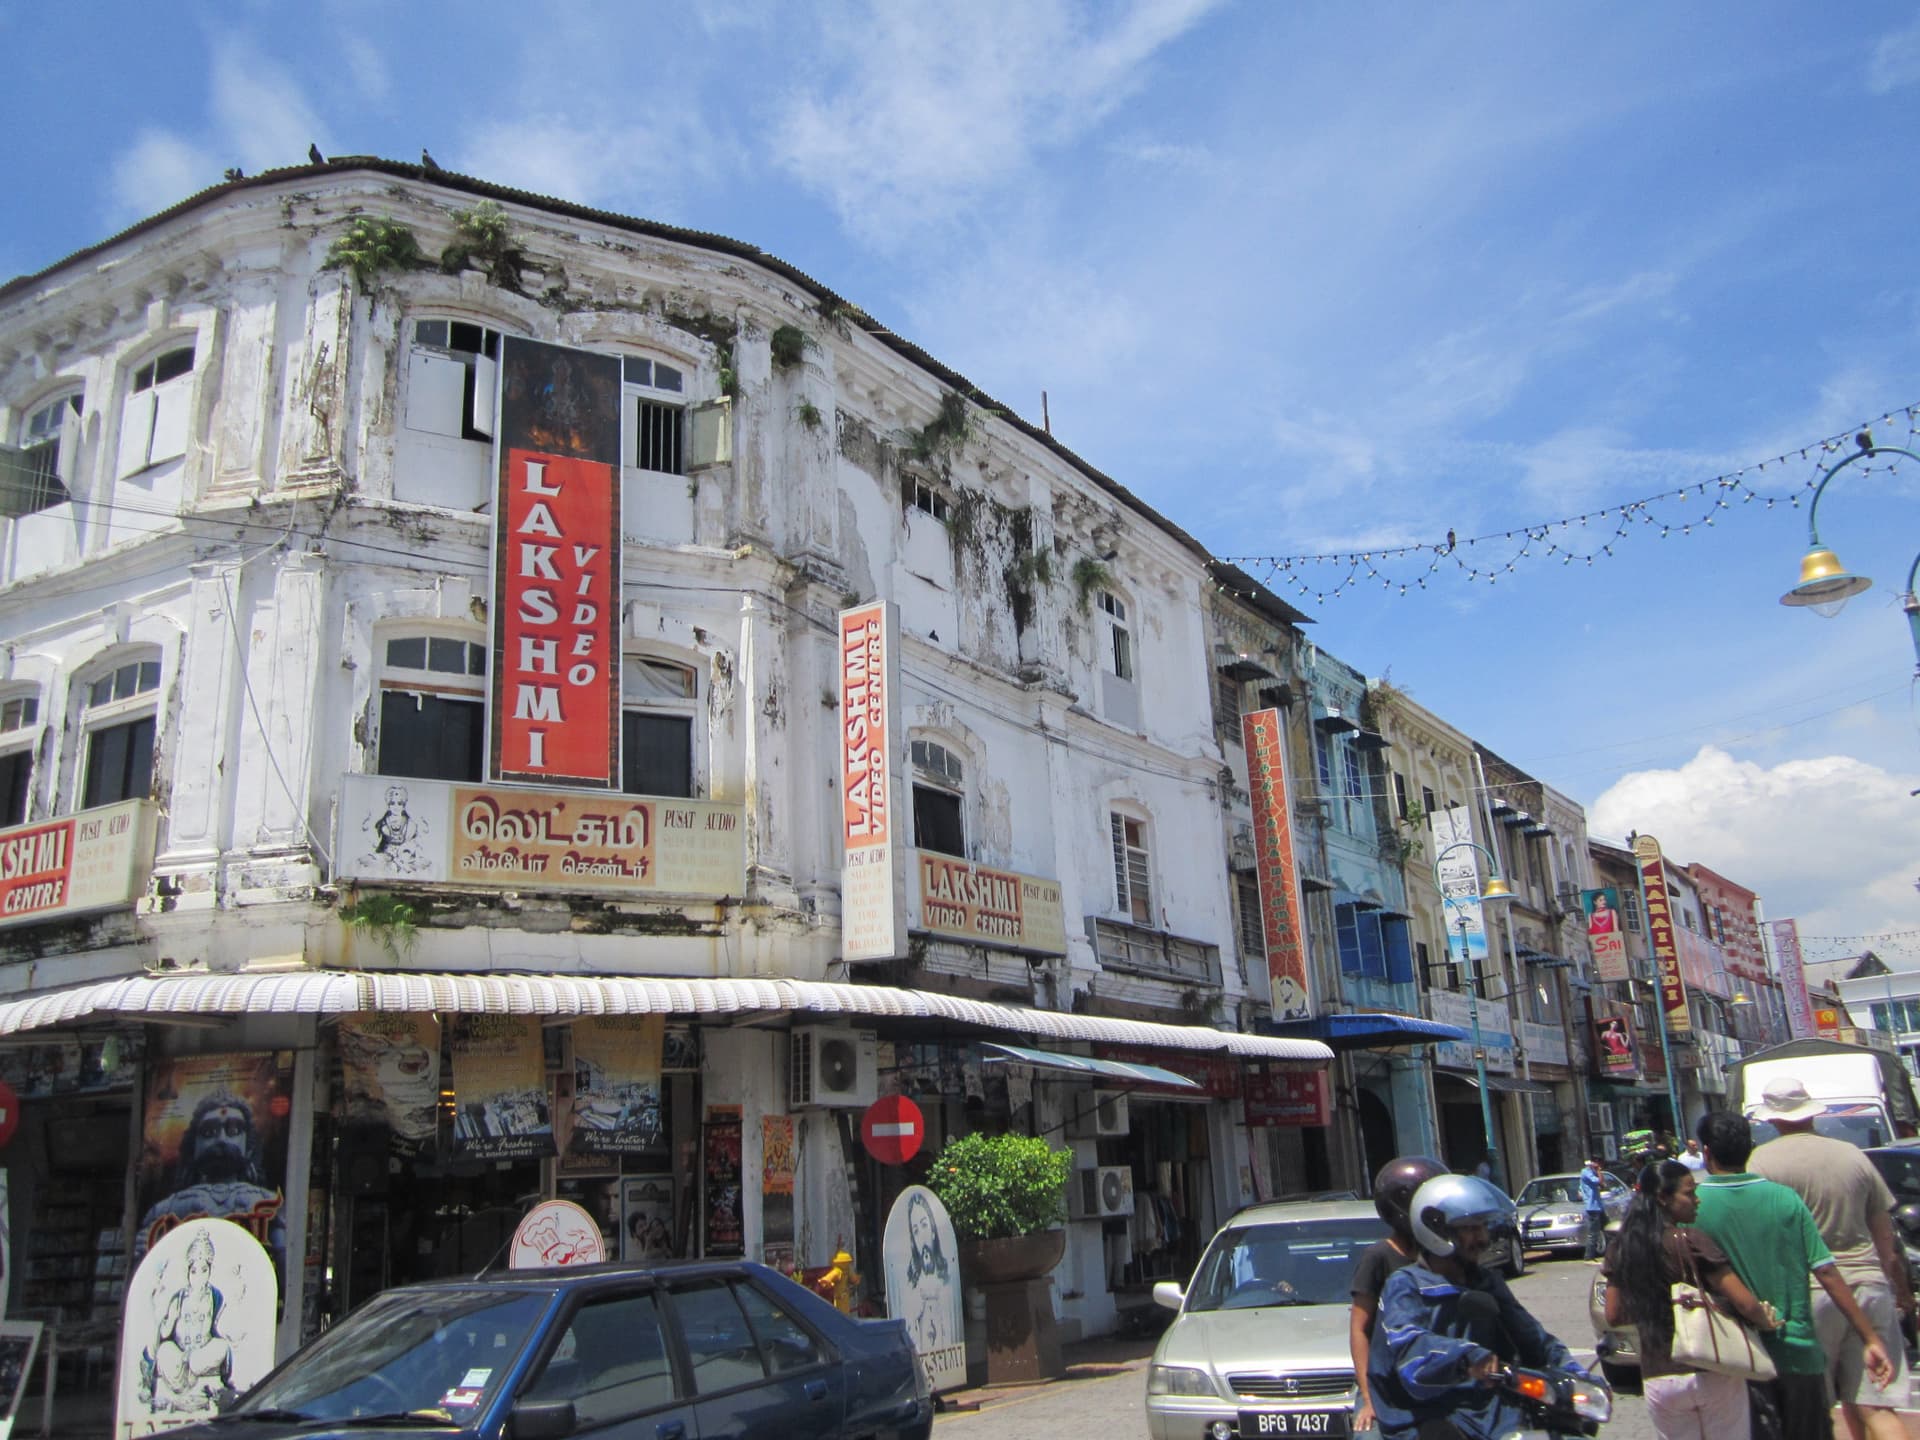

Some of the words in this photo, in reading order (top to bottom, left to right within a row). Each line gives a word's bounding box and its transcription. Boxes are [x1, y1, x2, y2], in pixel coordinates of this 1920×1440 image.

[513, 458, 568, 768] LAKSHMI
[567, 544, 601, 688] VIDEO
[867, 619, 882, 728] CENTRE
[845, 624, 868, 838] LAKSHMI
[870, 748, 885, 835] VIDEO
[80, 820, 103, 842] PUSAT
[109, 814, 130, 836] AUDIO
[664, 809, 696, 829] PUSAT
[705, 813, 736, 832] AUDIO
[849, 852, 865, 867] PUSAT
[869, 848, 886, 864] AUDIO
[4, 880, 63, 913] CENTRE
[925, 861, 1018, 914] LAKSHMI
[1023, 883, 1040, 900] PUSAT
[1042, 887, 1060, 904] AUDIO
[926, 901, 967, 929] VIDEO
[975, 910, 1021, 938] CENTRE
[1644, 874, 1679, 1001] KARAIKUDI
[1258, 1414, 1288, 1433] BFG
[1292, 1413, 1330, 1432] 7437
